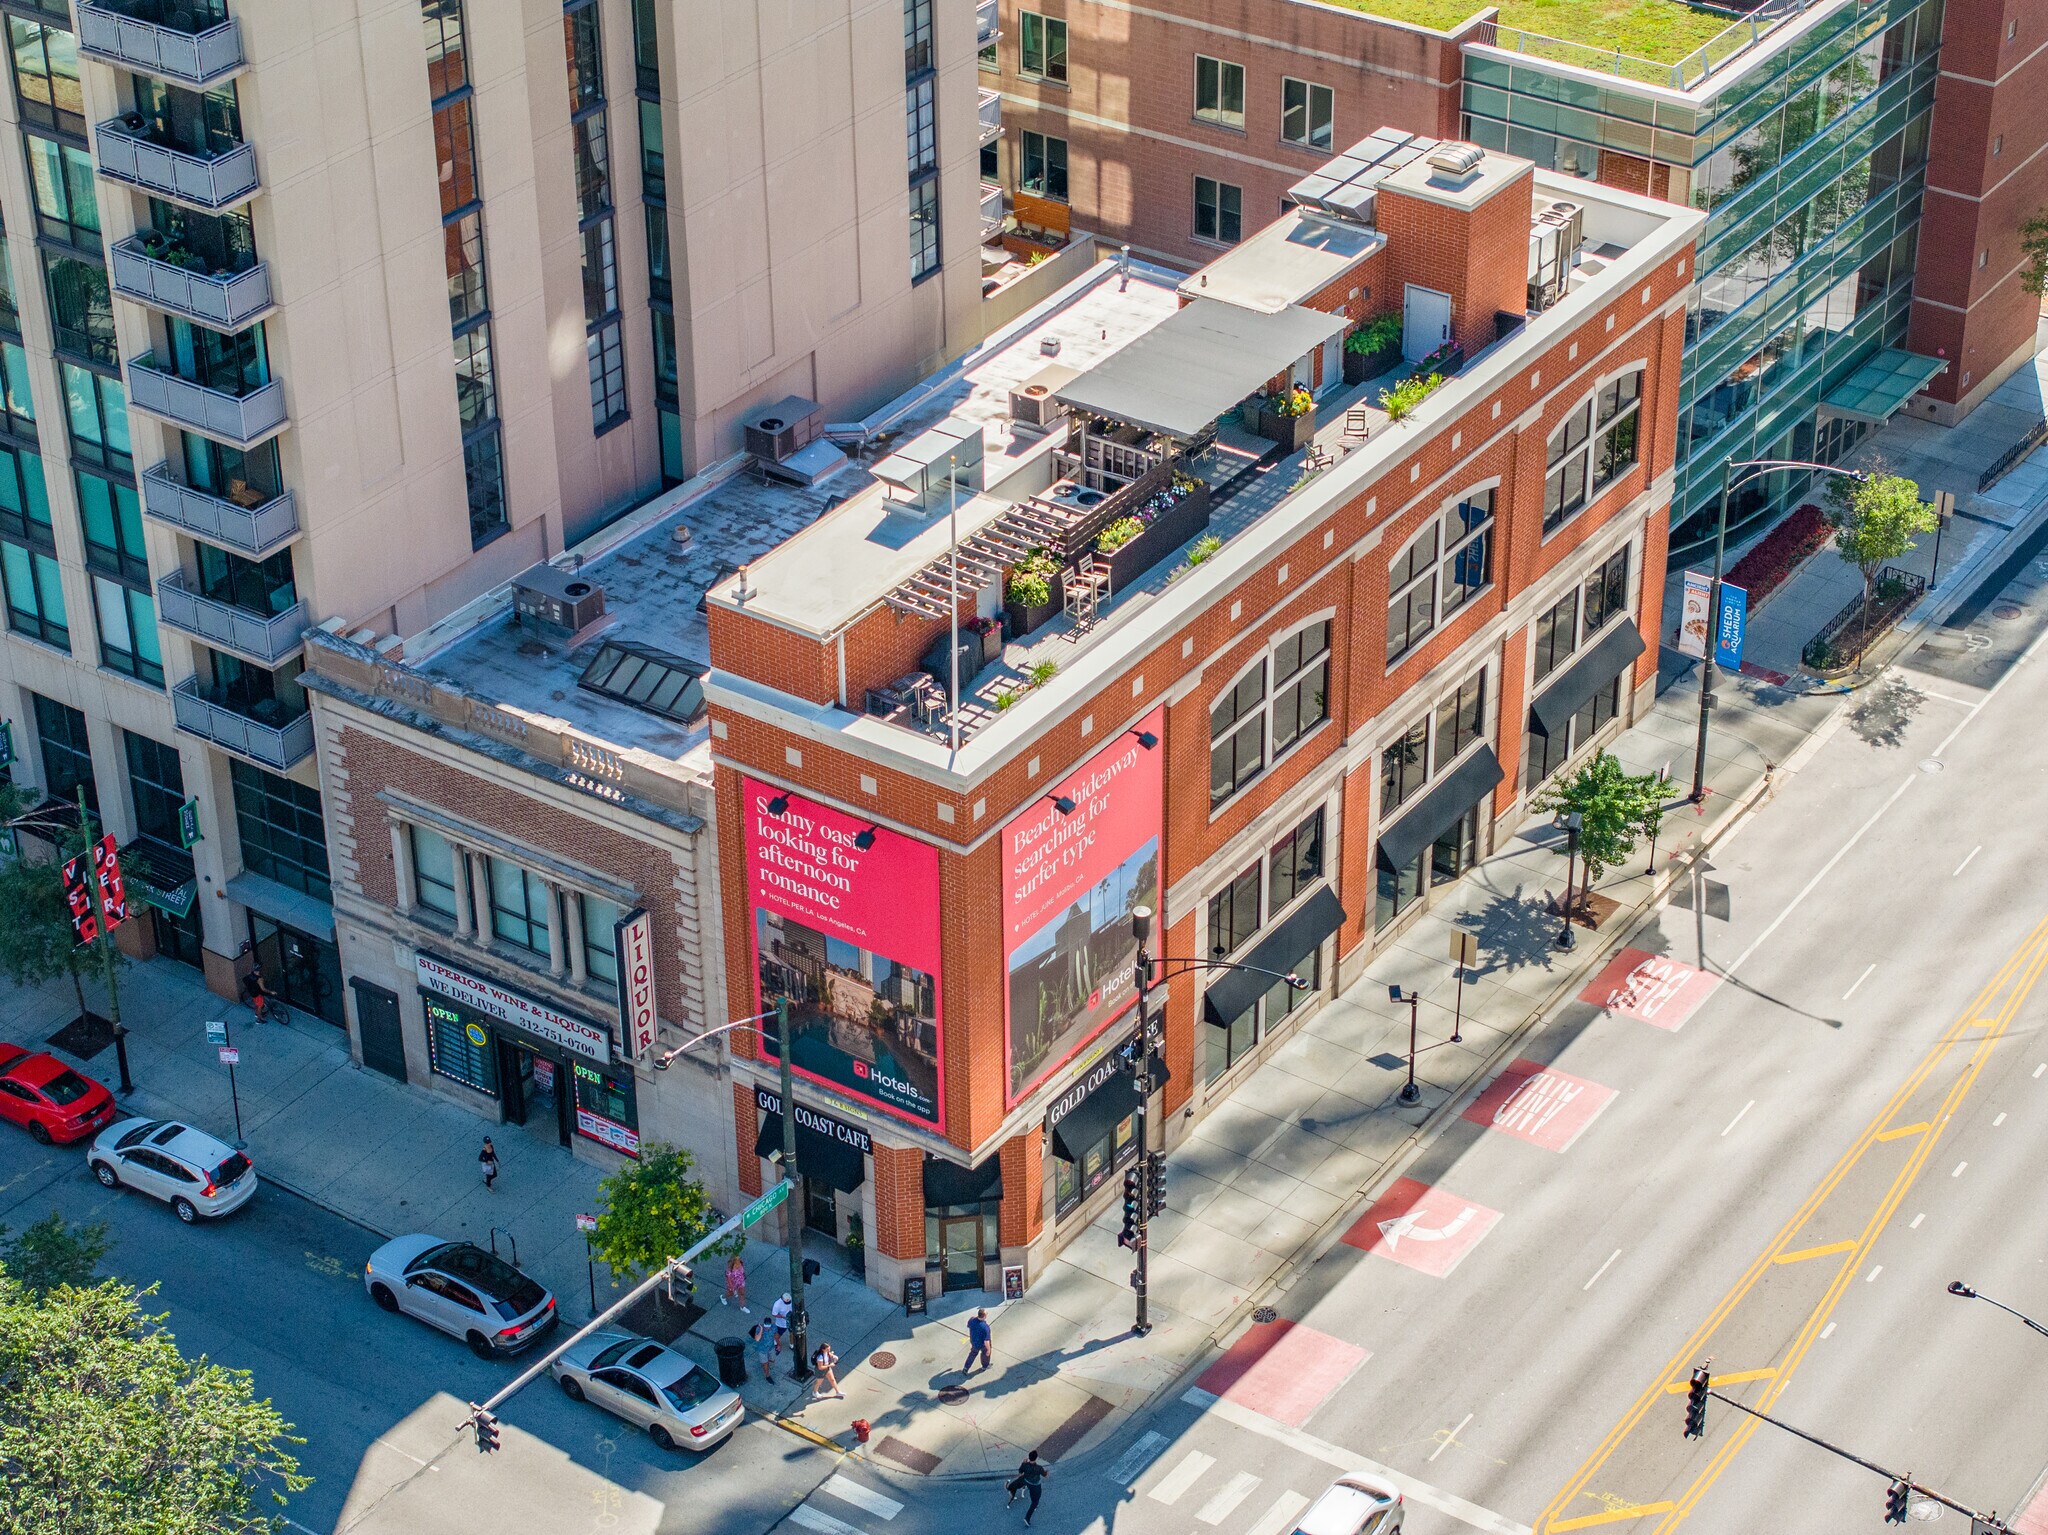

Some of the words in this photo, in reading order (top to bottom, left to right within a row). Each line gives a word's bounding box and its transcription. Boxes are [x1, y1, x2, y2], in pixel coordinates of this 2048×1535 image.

[1723, 605, 1733, 638] SHEDD
[1731, 609, 1741, 655] AQUARIUM
[1014, 805, 1066, 855] Beach
[1072, 744, 1140, 805] hideaway
[758, 817, 827, 865] looking
[832, 846, 859, 872] for
[1014, 812, 1086, 879] searching
[1088, 793, 1110, 821] for
[95, 846, 127, 919] POETRY
[759, 844, 851, 892] afternoon
[760, 867, 840, 909] romance
[1014, 857, 1060, 904] surfer
[1062, 830, 1096, 866] type
[65, 863, 92, 931] VISIT
[768, 892, 791, 907] HOTEL
[791, 902, 805, 912] PER
[805, 907, 814, 916] LA
[816, 912, 828, 921] Los
[856, 928, 867, 937] CA
[419, 958, 488, 995] SUPERIOR
[489, 987, 529, 1012] WINE
[531, 1006, 542, 1017] &
[544, 1011, 602, 1043] LIQUOR
[432, 1006, 458, 1022] OPEN
[632, 923, 652, 1050] LIQUOR
[1607, 958, 1694, 1019] BUS
[429, 976, 449, 994] WE
[451, 987, 507, 1019] DELIVER
[520, 1017, 595, 1056] 312-751-0700
[575, 1065, 601, 1085] OPEN
[879, 1088, 895, 1101] Book
[896, 1096, 905, 1104] on
[905, 1099, 916, 1109] the
[917, 1104, 930, 1115] app
[758, 1091, 784, 1116] GOL
[794, 1107, 835, 1137] COAST
[837, 1124, 869, 1152] CAFE
[1050, 1085, 1086, 1124] GOLD
[752, 1192, 777, 1215] CHICAGO
